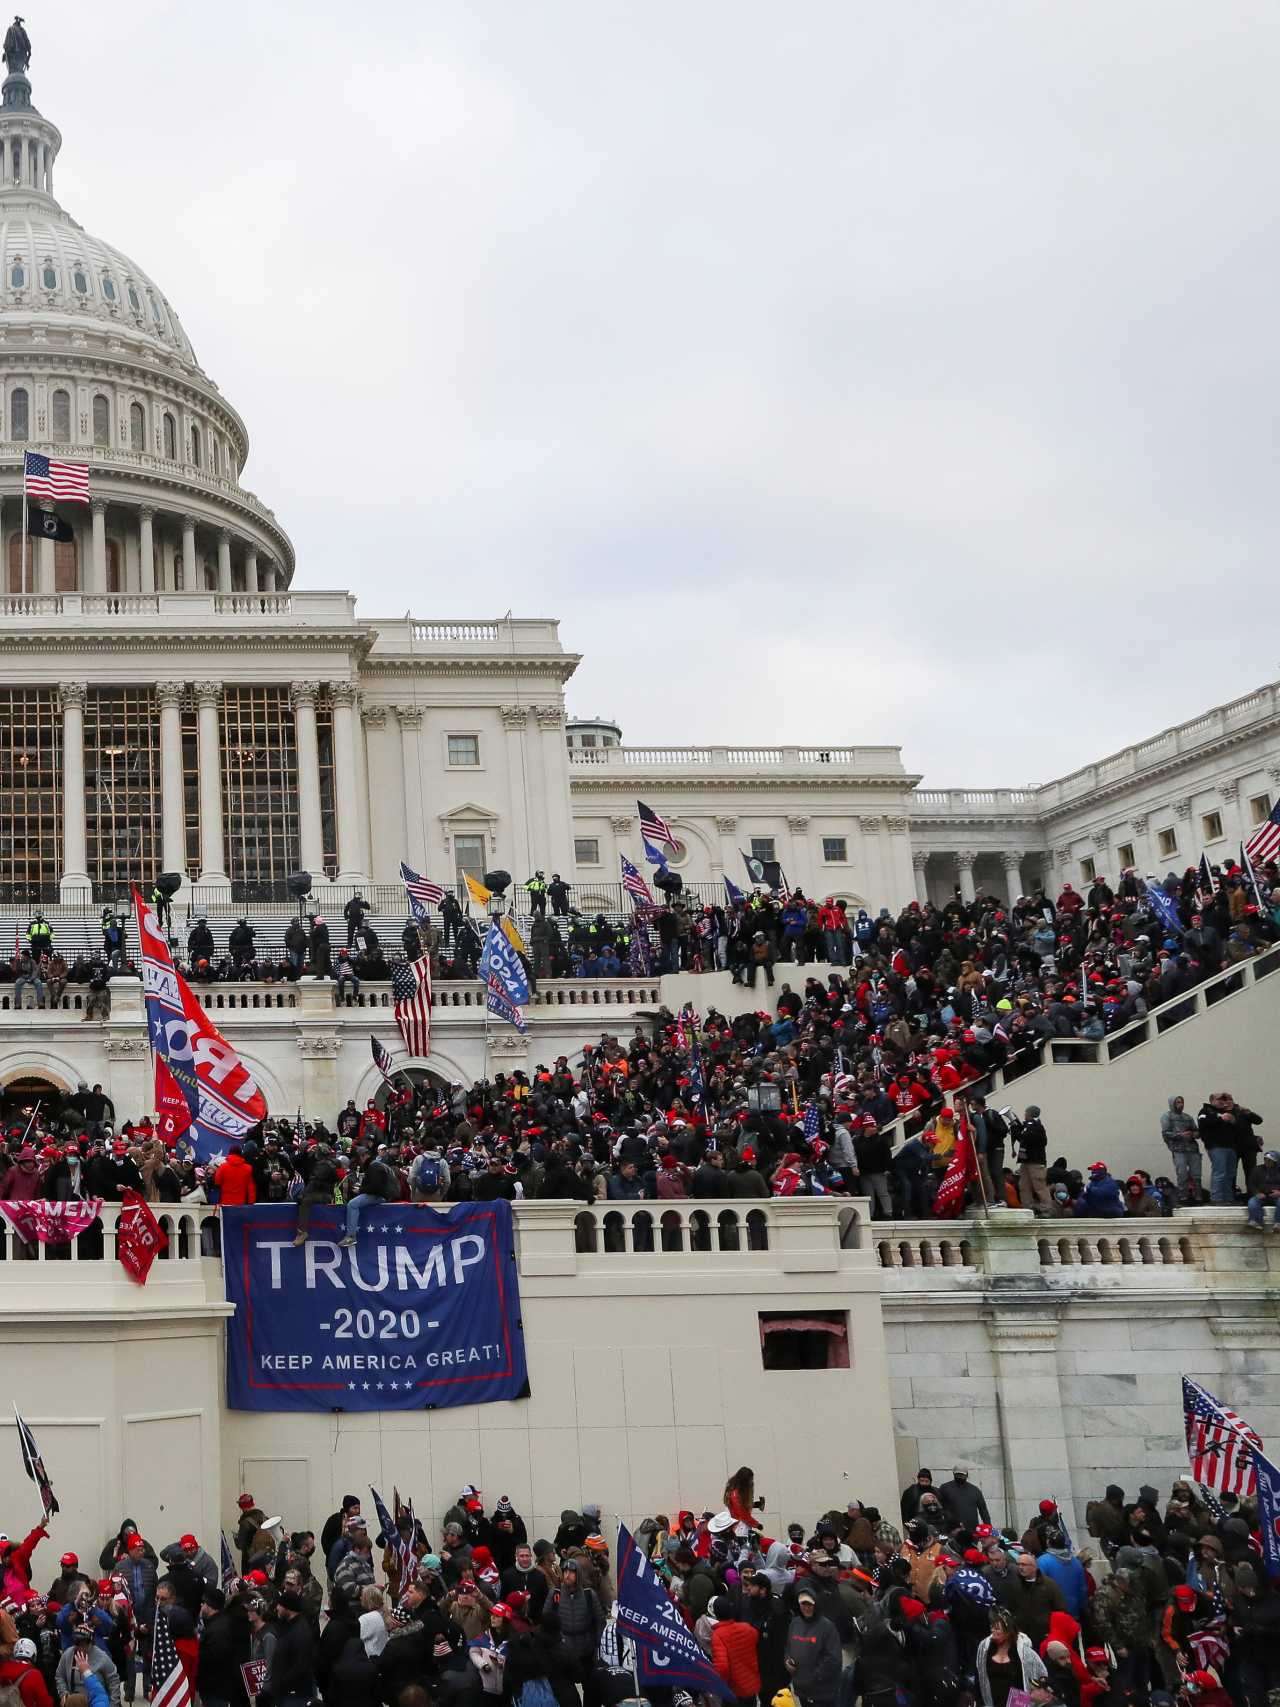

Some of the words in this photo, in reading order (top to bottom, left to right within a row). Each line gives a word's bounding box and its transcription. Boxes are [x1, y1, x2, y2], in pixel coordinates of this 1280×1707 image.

[162, 1096, 180, 1105] KEEP
[256, 1234, 485, 1292] TRUMP
[261, 1354, 313, 1370] KEEP
[321, 1355, 417, 1370] AMERICA
[426, 1343, 501, 1367] GREAT!
[618, 1606, 649, 1625] KEEP
